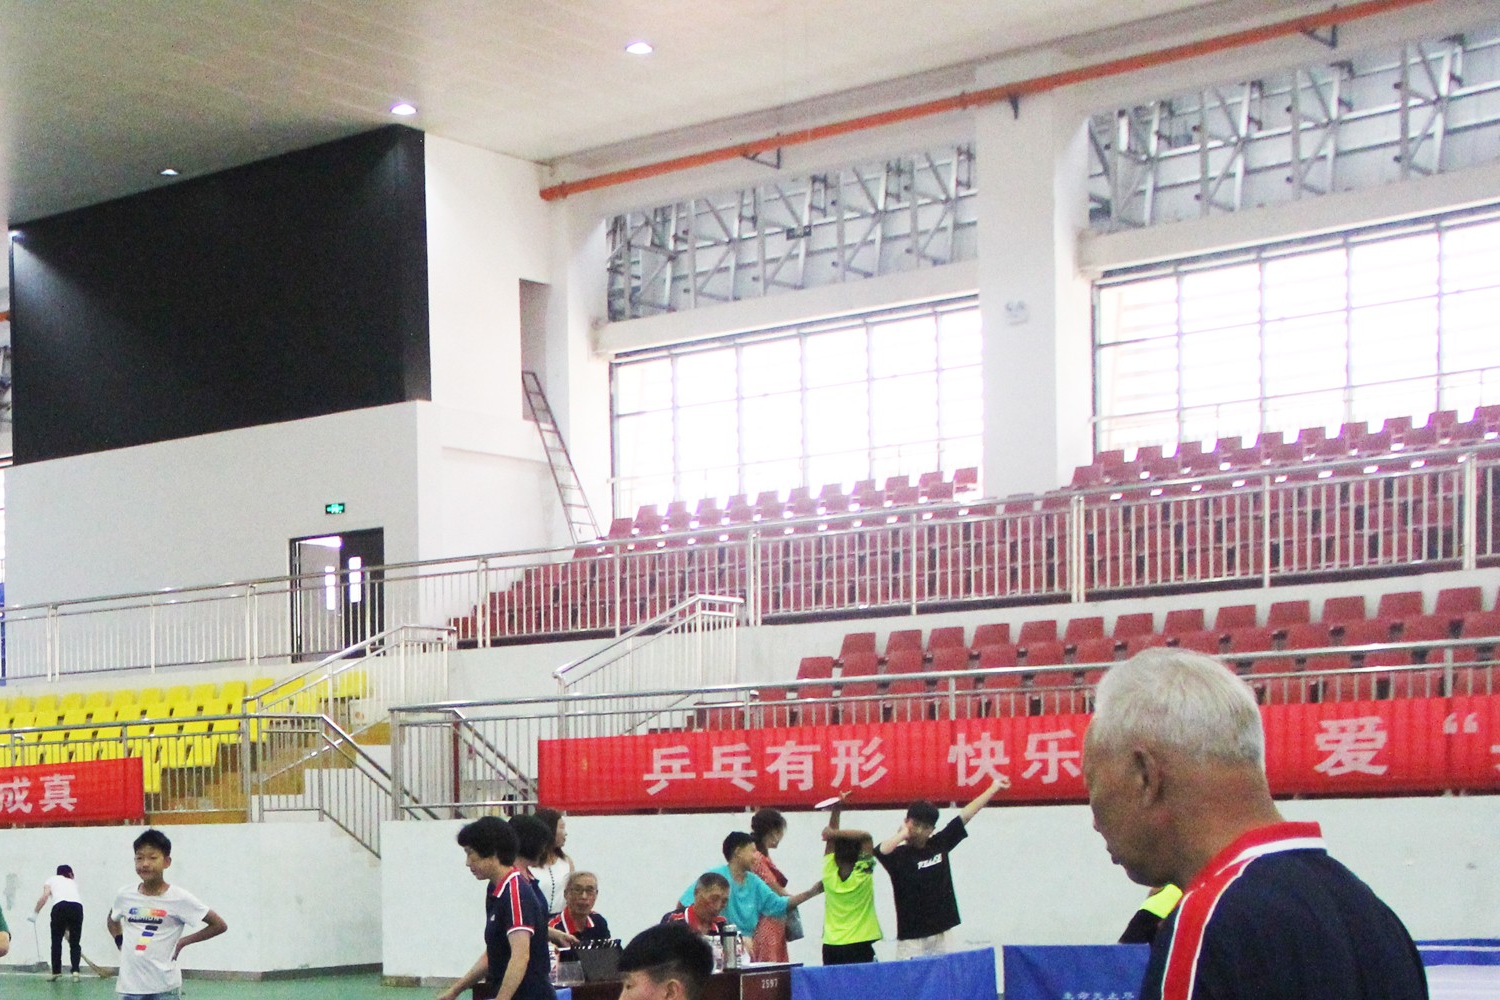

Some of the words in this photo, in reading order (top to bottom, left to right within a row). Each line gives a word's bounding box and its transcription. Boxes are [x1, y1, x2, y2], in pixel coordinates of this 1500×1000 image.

[643, 736, 889, 796] 乒乓有形
[947, 729, 1082, 787] 快乐
[761, 978, 779, 989] 2597
